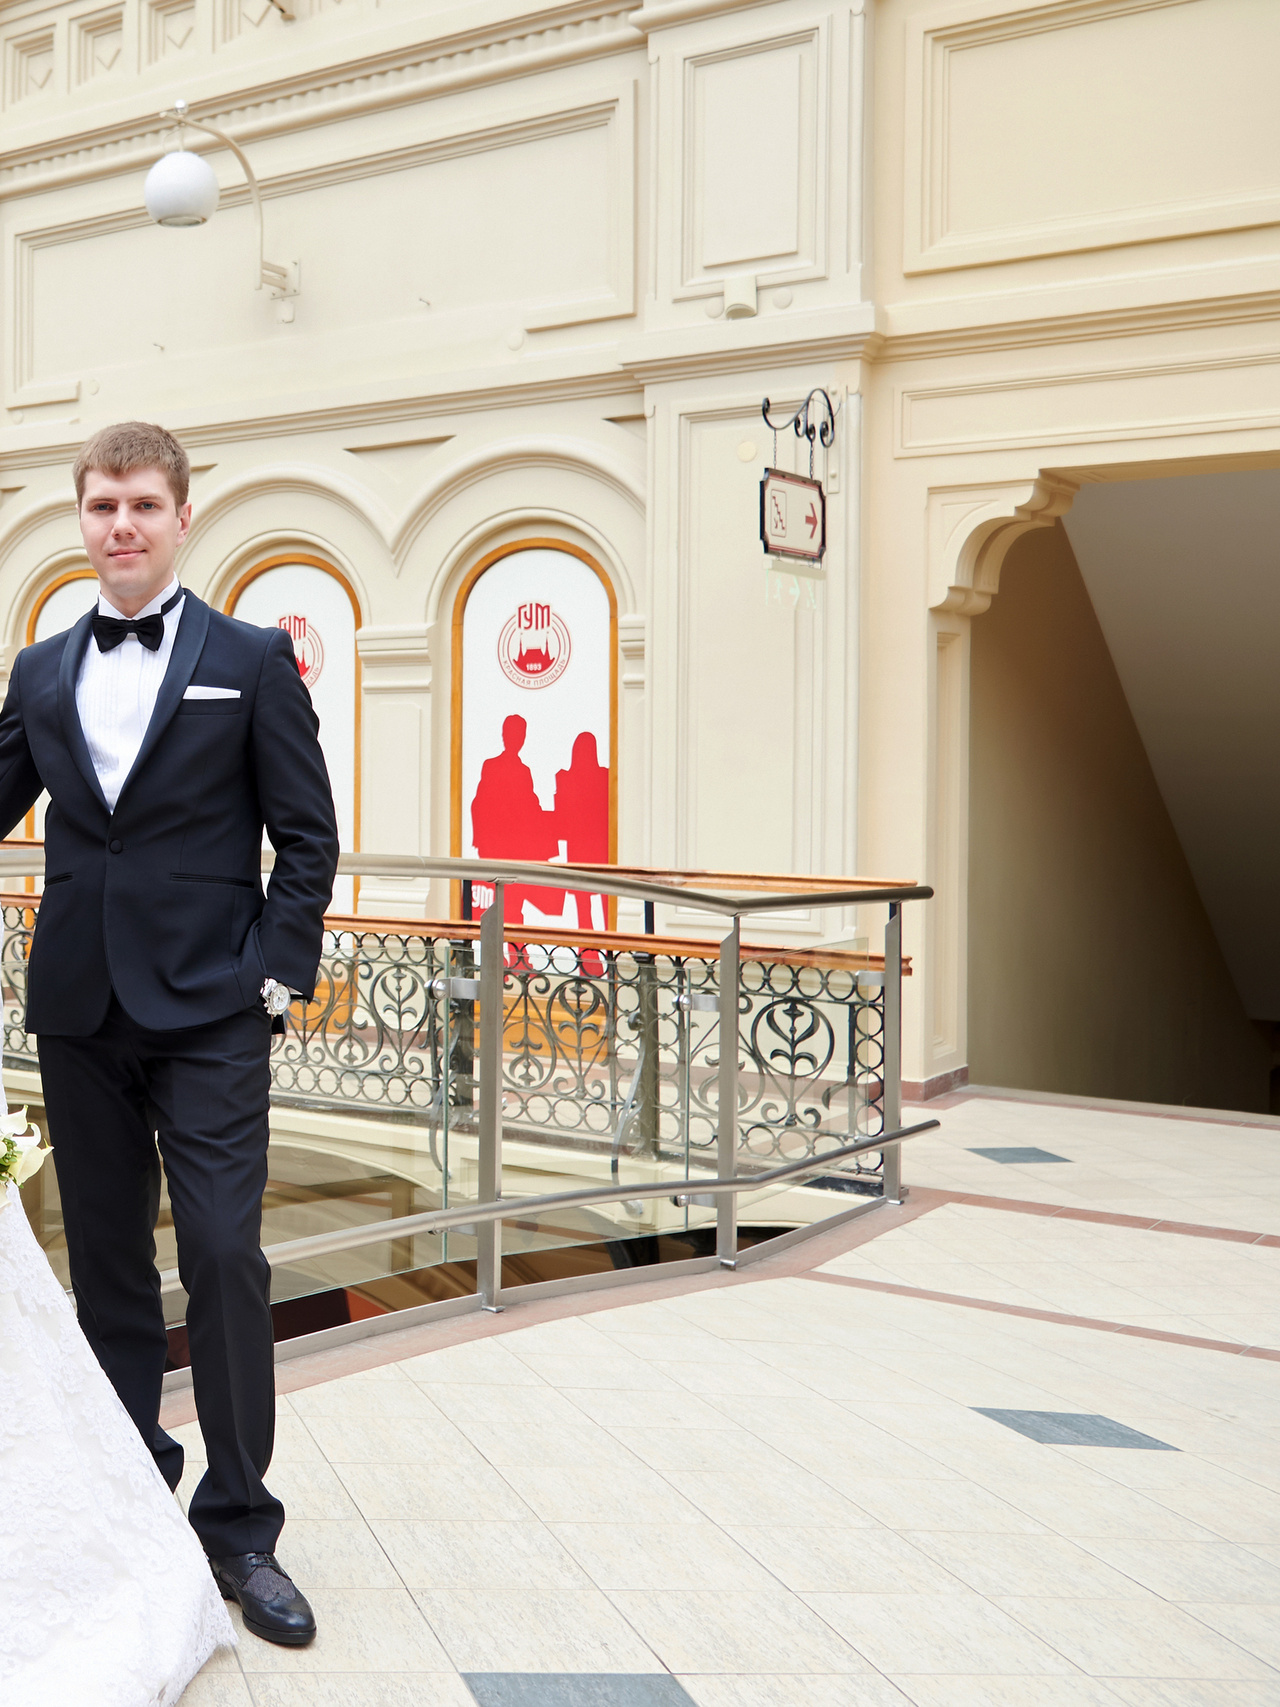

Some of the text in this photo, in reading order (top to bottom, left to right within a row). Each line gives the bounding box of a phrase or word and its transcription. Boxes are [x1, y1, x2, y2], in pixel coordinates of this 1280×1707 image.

[518, 602, 550, 630] ГУМ
[504, 659, 566, 687] КРАСНАЯ ПЛОЩАДЬ
[471, 885, 494, 909] УМ
